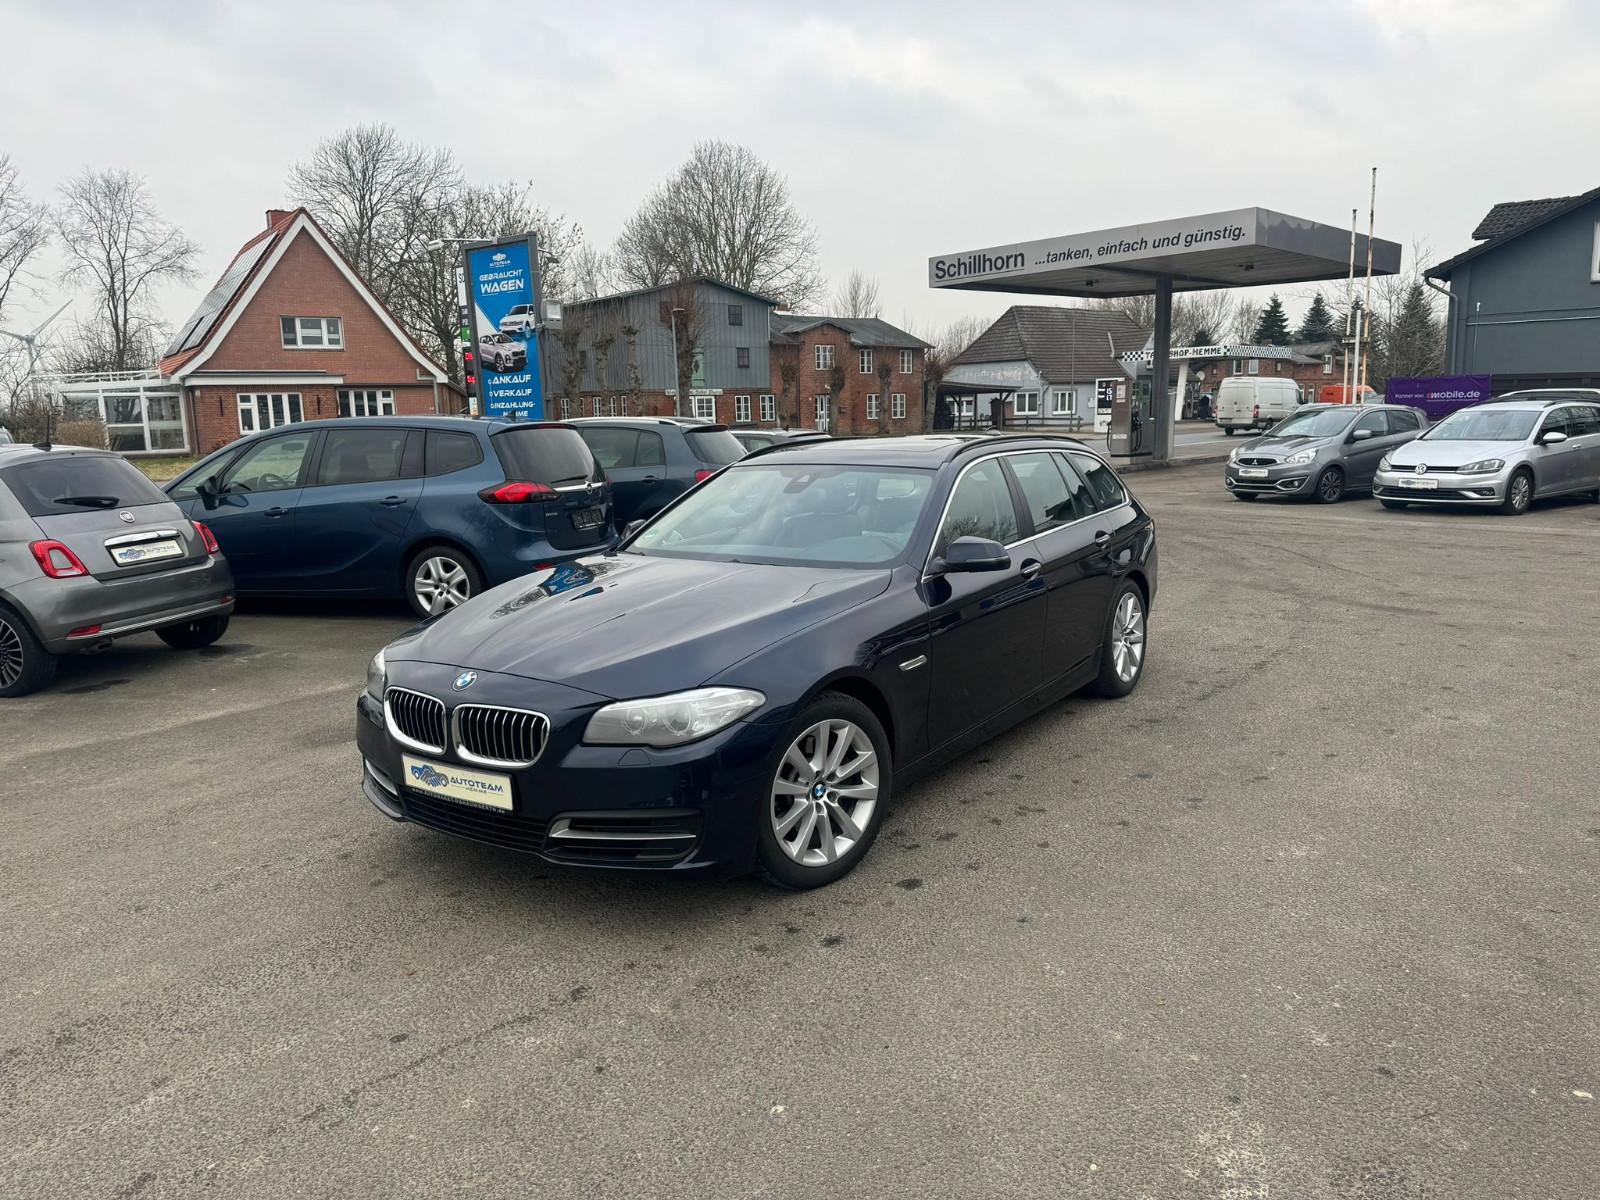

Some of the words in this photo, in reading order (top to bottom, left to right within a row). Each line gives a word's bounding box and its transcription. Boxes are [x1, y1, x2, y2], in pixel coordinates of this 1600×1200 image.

[935, 252, 1025, 279] Schillhorn
[1035, 247, 1092, 265] ...tanken,
[1097, 237, 1148, 257] einfach
[1152, 232, 1181, 249] und
[1184, 224, 1246, 248] günstig.
[479, 268, 523, 281] GEBRAUCHT
[480, 278, 524, 294] WAGEN
[492, 374, 532, 384] ANKAUF
[493, 388, 532, 397] VERKAUF
[1430, 390, 1481, 399] mobile.de
[450, 776, 504, 792] AUTOTEAM
